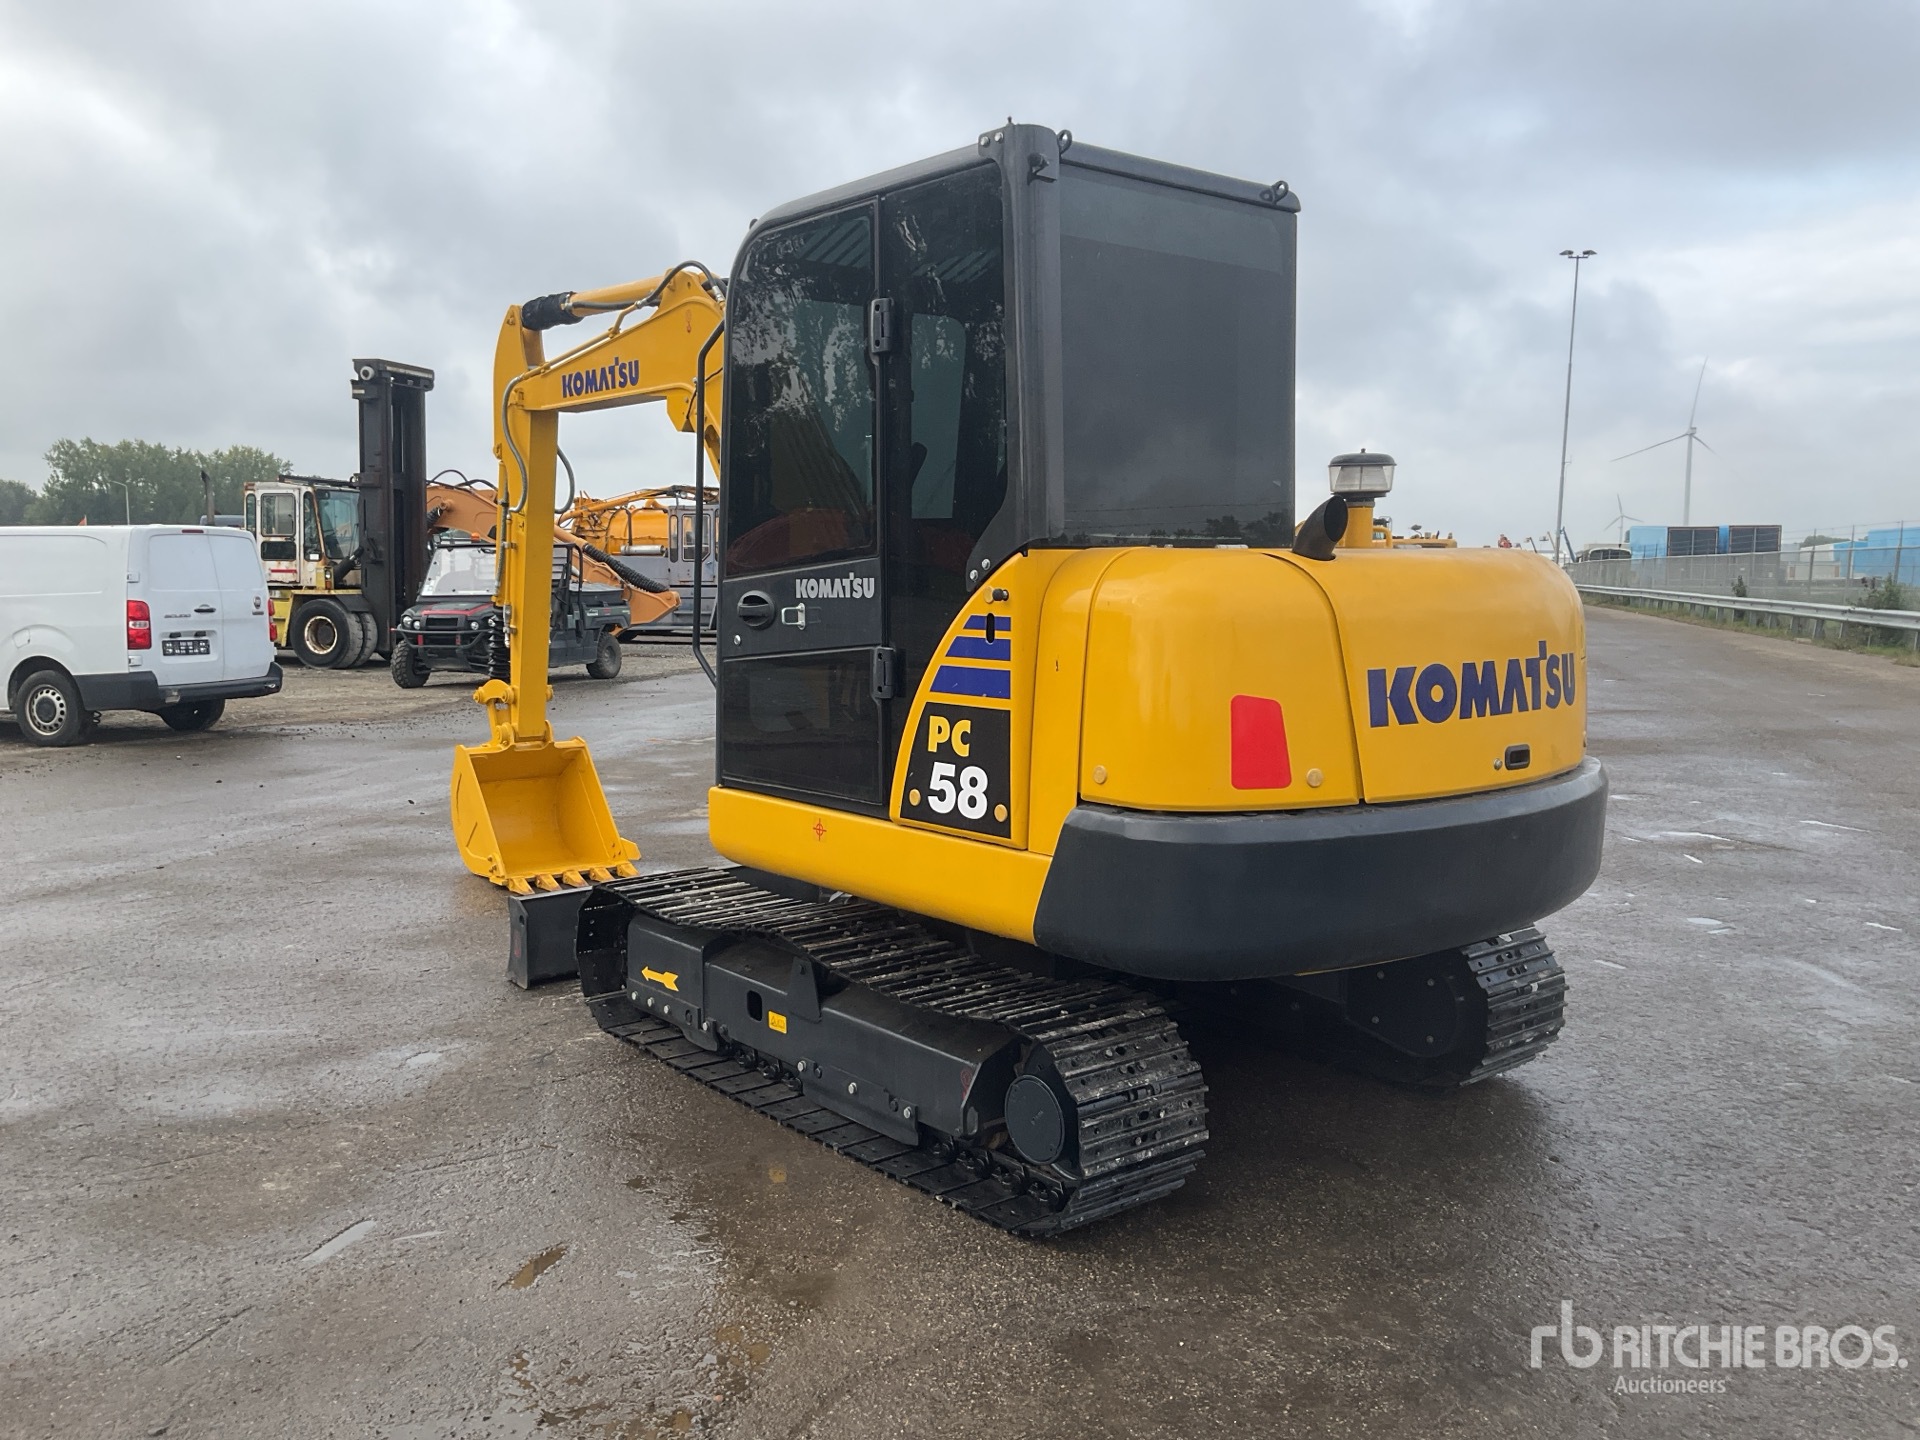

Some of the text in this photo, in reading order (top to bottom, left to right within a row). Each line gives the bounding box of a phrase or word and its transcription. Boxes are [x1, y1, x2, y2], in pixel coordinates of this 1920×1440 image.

[562, 357, 640, 398] KOMATSU
[795, 572, 875, 599] KOMATSU
[1367, 640, 1576, 728] KOMATSU
[927, 715, 972, 757] PC
[927, 761, 989, 820] 58
